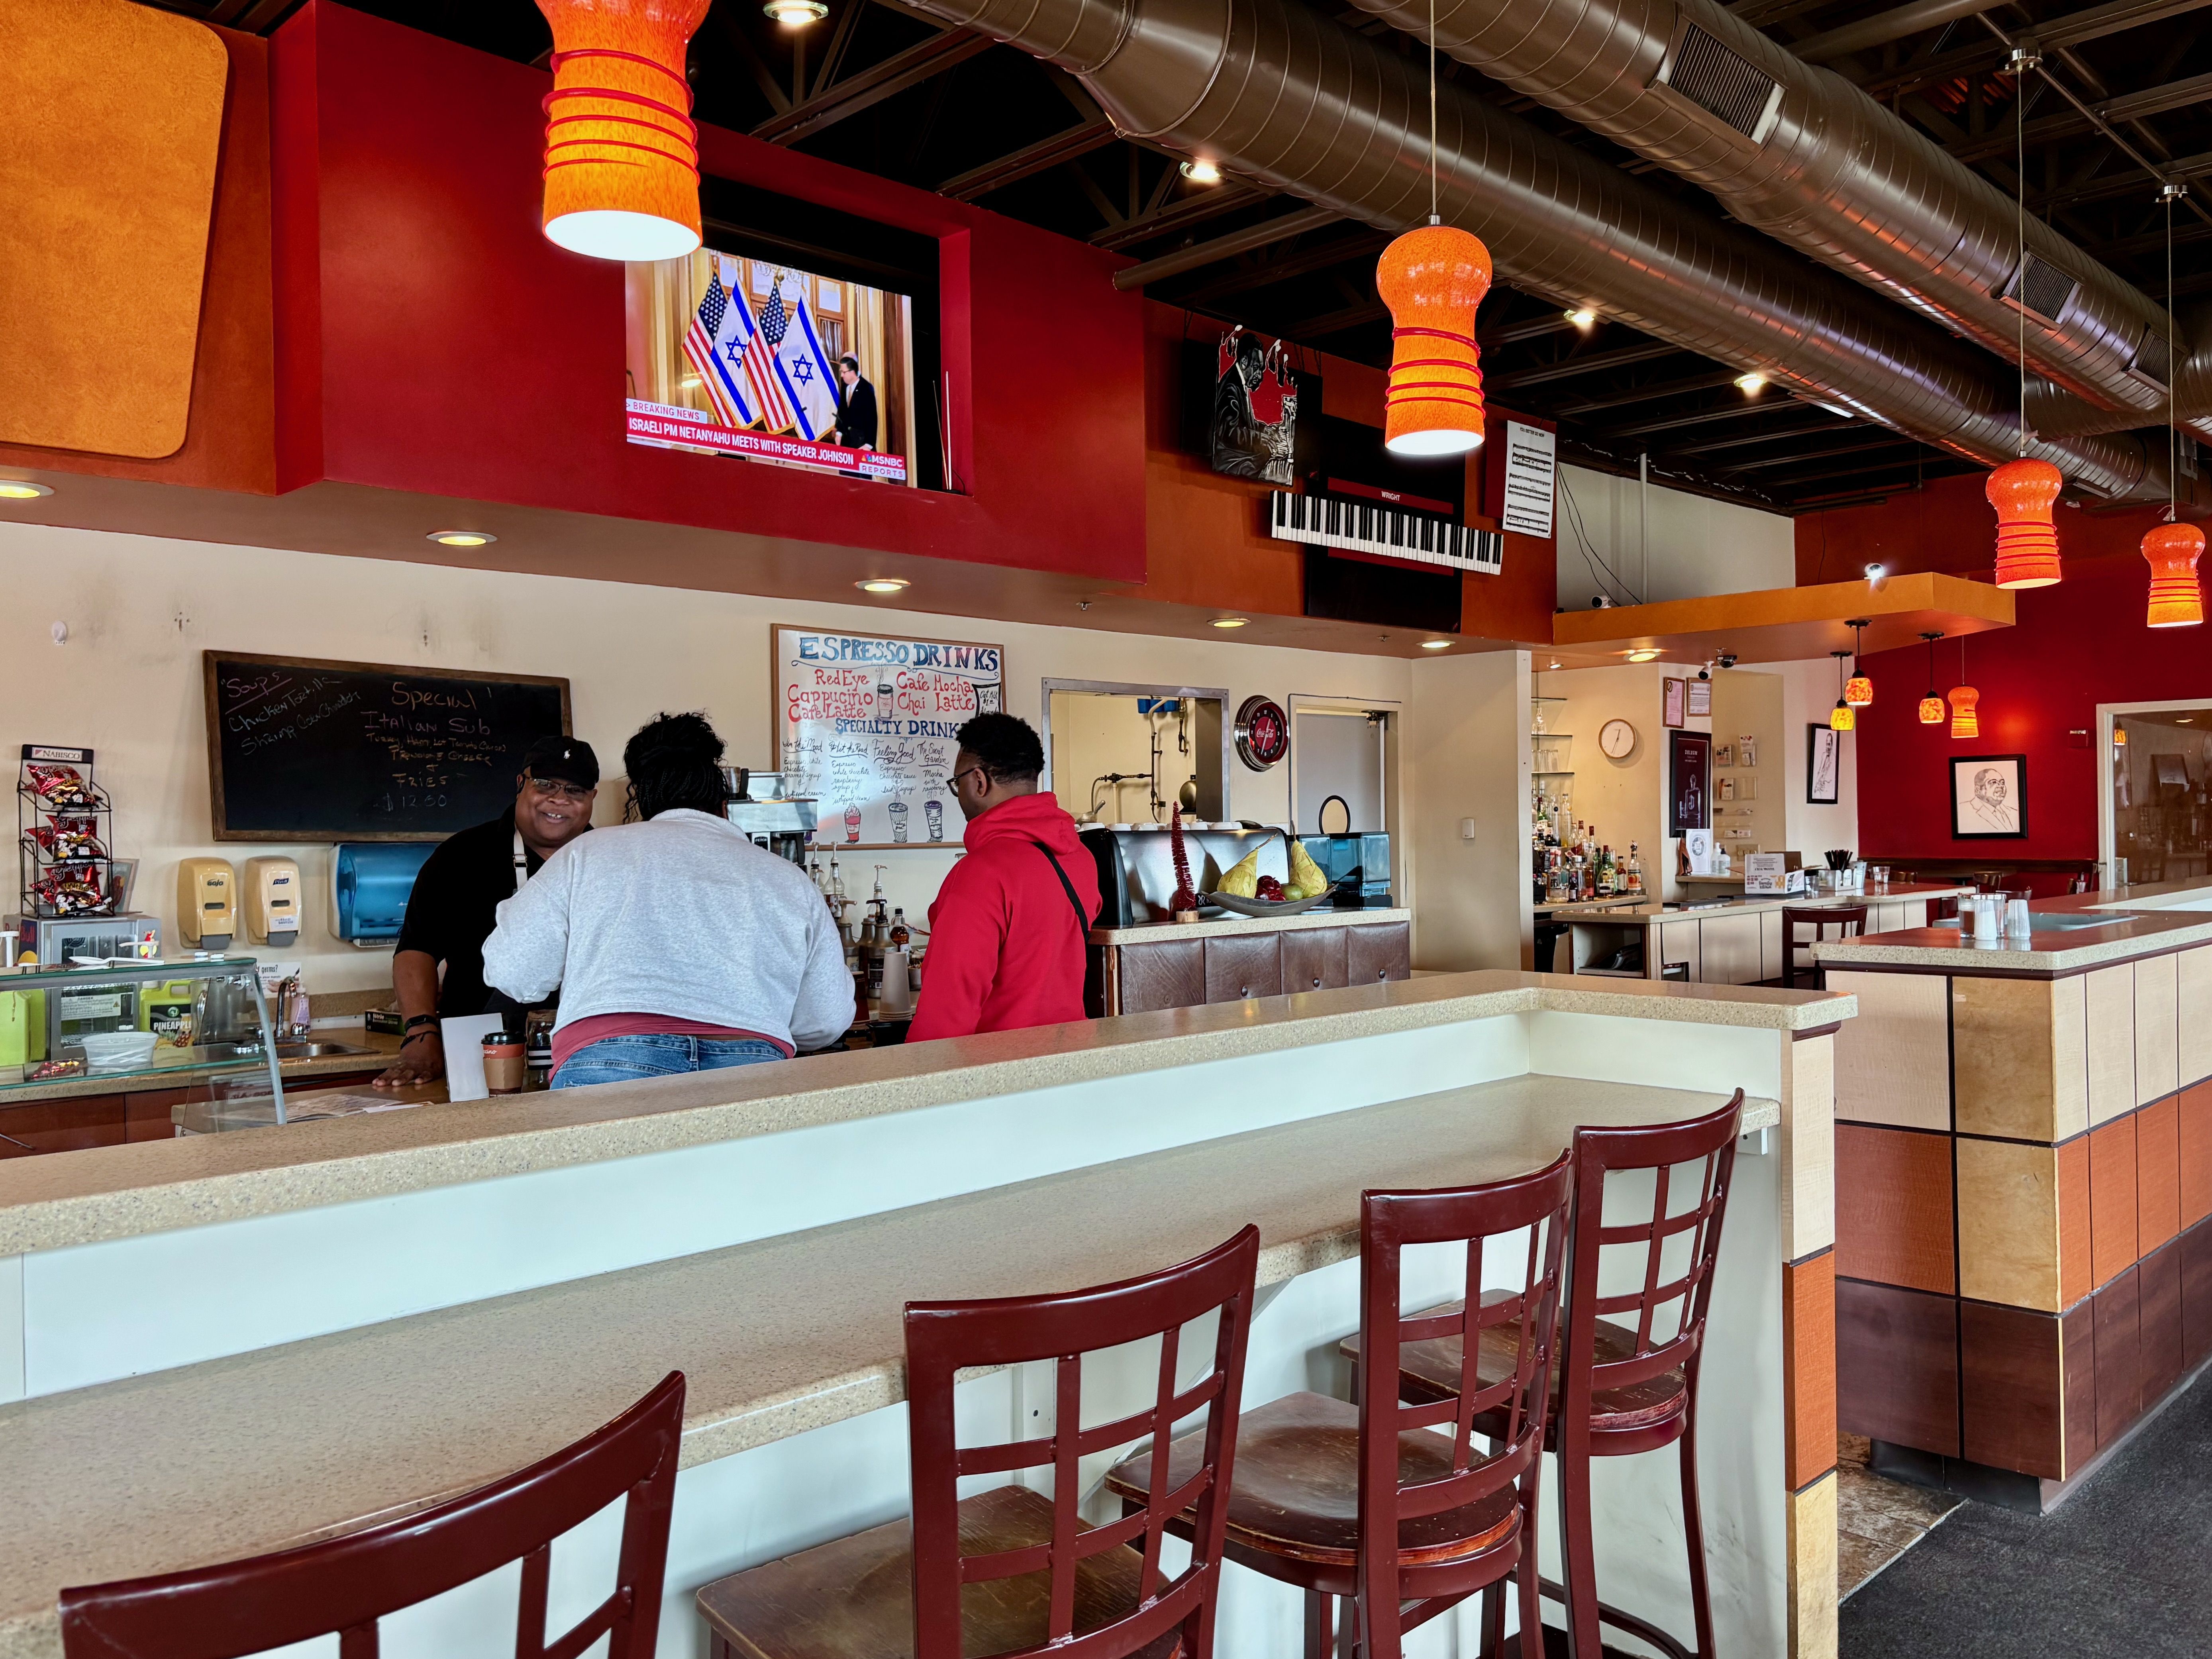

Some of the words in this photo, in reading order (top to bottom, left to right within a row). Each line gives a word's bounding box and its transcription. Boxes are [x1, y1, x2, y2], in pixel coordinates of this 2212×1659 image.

[633, 402, 674, 416] BREAKING
[677, 409, 699, 420] NEWS
[629, 417, 662, 434] ISRAELI
[664, 422, 677, 437] PM
[679, 426, 730, 445] NETANYAHU
[732, 434, 759, 450] MEETS
[760, 439, 781, 454] WITH
[782, 442, 817, 459] SPEAKER
[818, 449, 854, 465] JOHNSON
[872, 454, 903, 468] MSNBC
[862, 465, 903, 477] REPORTS
[1381, 491, 1400, 501] WRIGHT
[799, 637, 909, 664] ESPRESSO
[913, 643, 998, 671] DRINKS
[814, 669, 841, 685] Red
[842, 669, 870, 692] Eye
[896, 671, 930, 691] Cafe
[933, 674, 974, 697] Mocha
[392, 681, 477, 711] Special
[787, 684, 873, 713] Cappucino
[897, 692, 926, 716] Chai
[935, 692, 975, 712] Latte
[825, 703, 867, 719] Latte
[360, 711, 437, 732] Italian
[449, 718, 490, 735] Sub
[835, 718, 903, 734] SPECIALTY
[907, 720, 960, 738] DRINK
[43, 750, 80, 759] NABISCO
[872, 738, 897, 758] Feeling
[917, 740, 927, 756] The
[924, 754, 949, 765] Garden
[923, 769, 944, 777] Mocha
[261, 964, 278, 975] germs?
